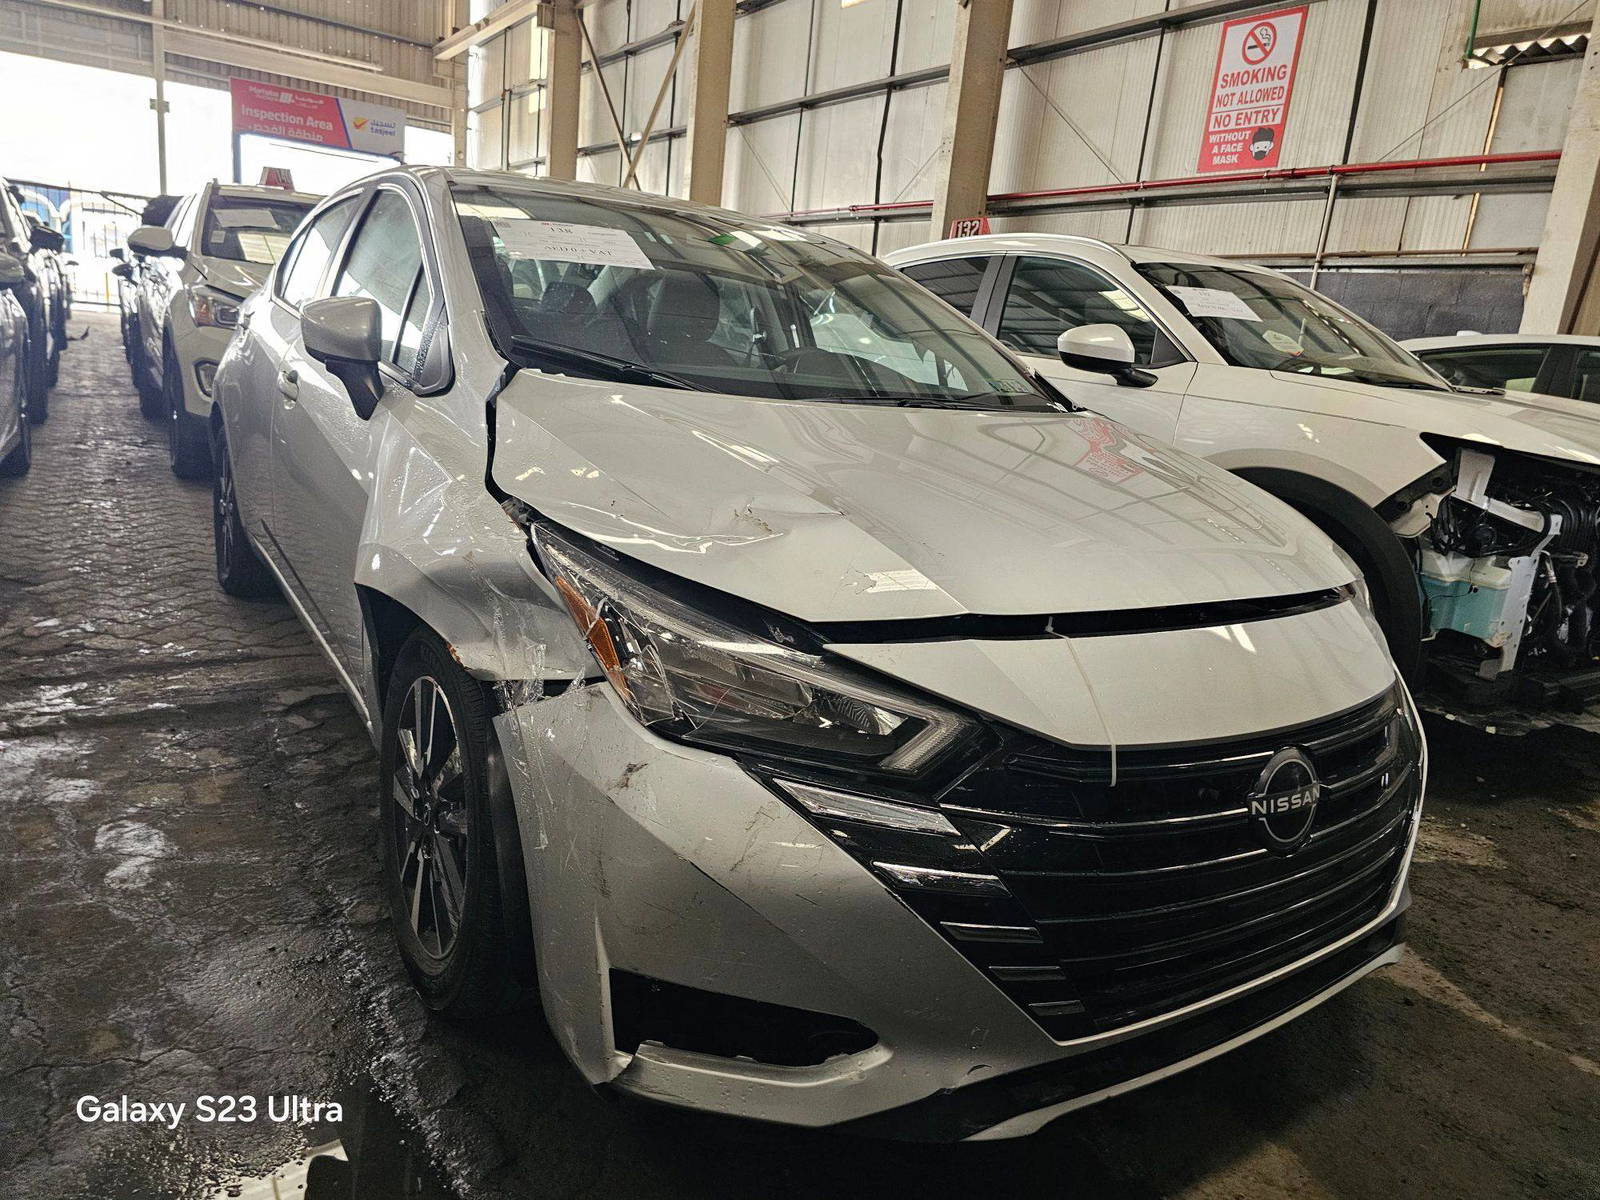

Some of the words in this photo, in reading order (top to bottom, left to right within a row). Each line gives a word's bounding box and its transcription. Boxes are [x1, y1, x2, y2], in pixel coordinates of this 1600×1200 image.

[1220, 64, 1287, 89] SMOKING
[1216, 92, 1234, 108] NOT
[1237, 86, 1284, 105] ALLOWED
[241, 104, 304, 125] Inspection
[306, 116, 333, 131] Area
[1213, 114, 1231, 129] NO
[1235, 107, 1280, 127] ENTRY
[1209, 130, 1251, 144] WITHOUT
[1212, 145, 1219, 154] A
[1220, 143, 1243, 154] FACE
[1213, 154, 1238, 165] MASK
[957, 220, 980, 238] 132
[1251, 787, 1320, 815] NISSAN
